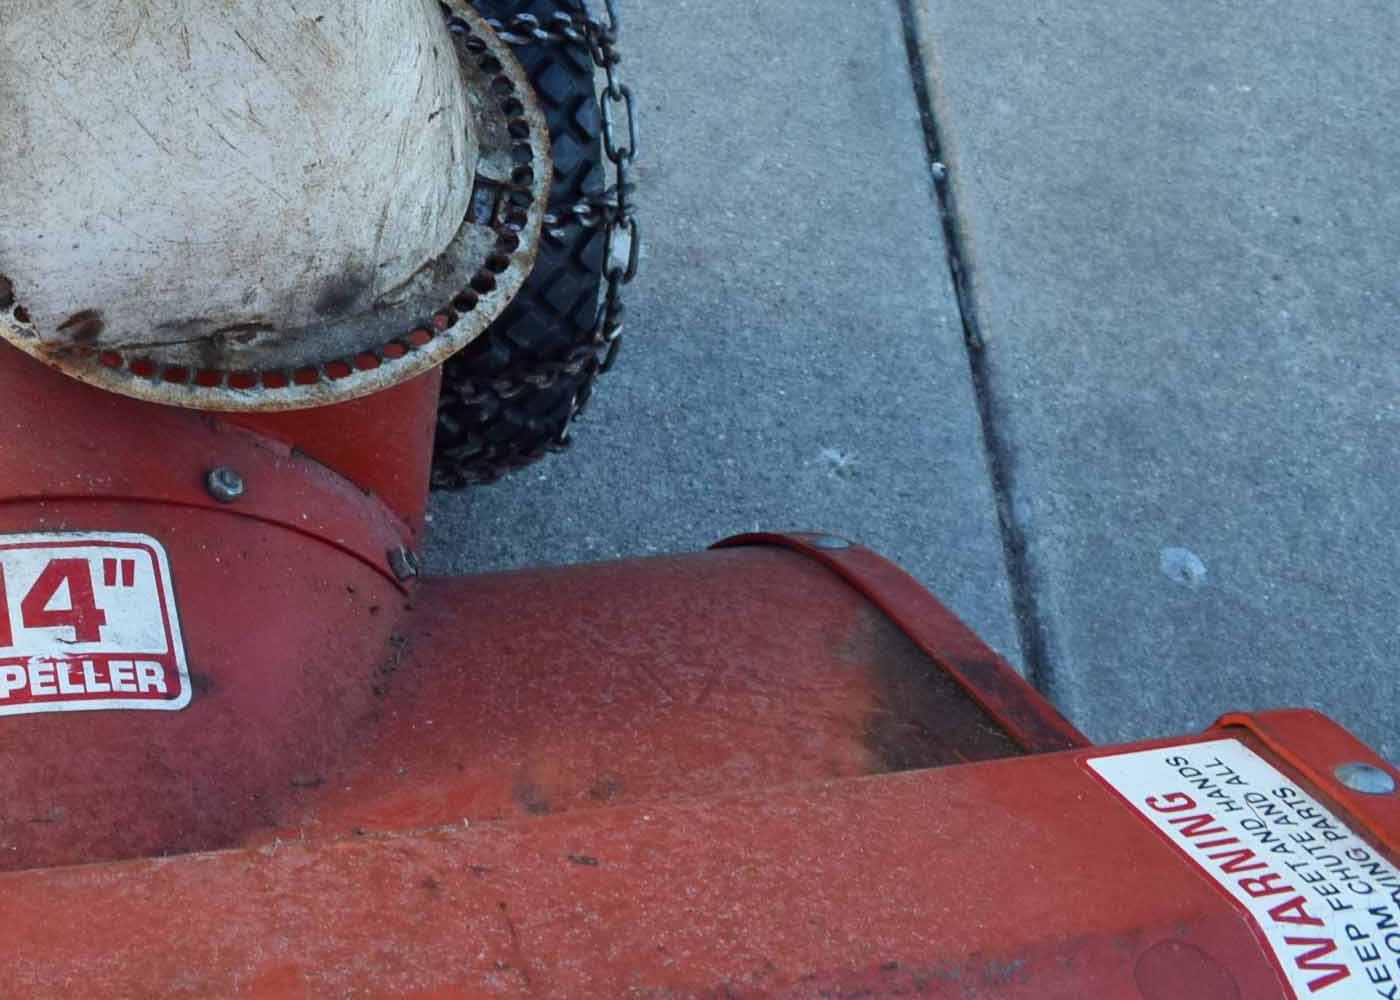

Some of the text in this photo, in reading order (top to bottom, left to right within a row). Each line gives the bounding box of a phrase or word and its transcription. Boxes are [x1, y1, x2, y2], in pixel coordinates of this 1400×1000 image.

[1164, 755, 1244, 813] HANDS
[1204, 757, 1251, 787] ALL
[1243, 792, 1299, 827] AND
[1271, 786, 1349, 842] PARTS
[1239, 818, 1297, 856] AND
[1290, 830, 1374, 896] CHUTE
[1145, 790, 1352, 993] WARNING
[1285, 861, 1354, 912] FEET
